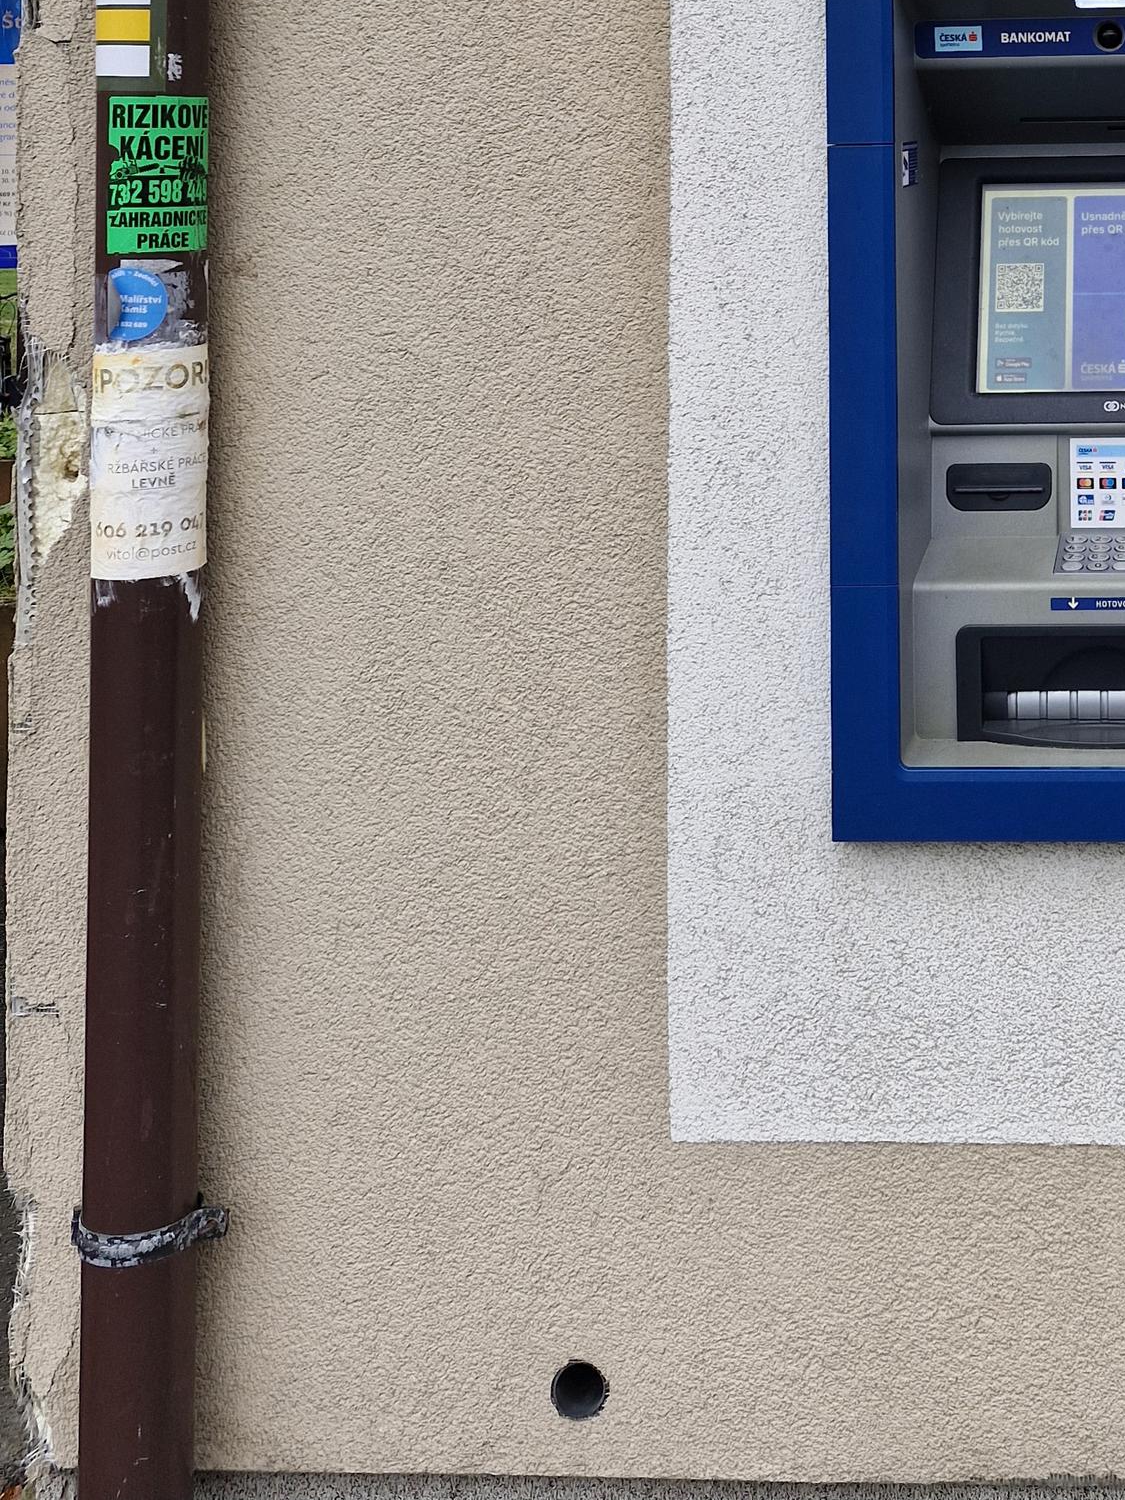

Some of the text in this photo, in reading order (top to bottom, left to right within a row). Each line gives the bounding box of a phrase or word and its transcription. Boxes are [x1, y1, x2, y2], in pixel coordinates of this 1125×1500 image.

[939, 32, 967, 42] ČESKÁ
[1000, 31, 1072, 43] BANKOMAT
[112, 100, 208, 129] RIZIKOVÉ
[119, 129, 204, 161] KÁCENÍ
[109, 179, 143, 206] 732
[148, 179, 183, 204] 598
[998, 211, 1044, 224] Vybírejte
[998, 225, 1043, 234] hotovost
[1081, 225, 1105, 236] přes
[1107, 224, 1123, 234] QR
[137, 230, 189, 249] PRÁCE
[998, 236, 1060, 248] přes QR kód
[1081, 362, 1116, 373] ČESKÁ
[131, 472, 176, 489] LEVNĚ
[135, 521, 173, 537] 219
